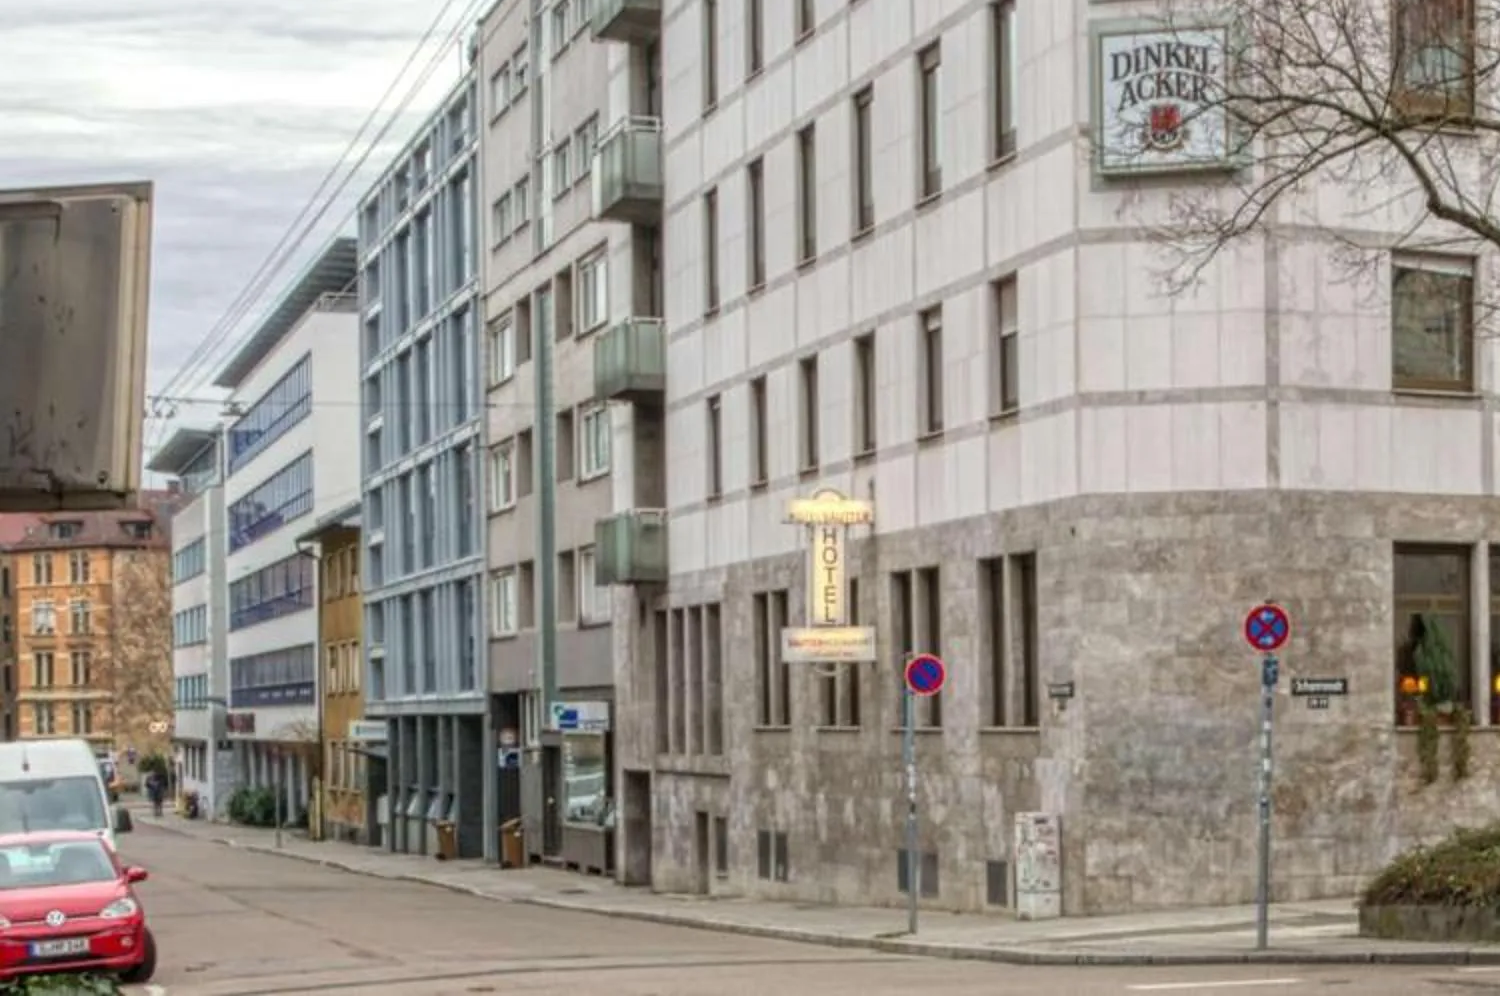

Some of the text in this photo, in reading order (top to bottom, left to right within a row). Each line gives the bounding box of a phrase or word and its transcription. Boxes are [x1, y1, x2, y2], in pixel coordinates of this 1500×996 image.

[1110, 42, 1217, 82] DINKEL
[1118, 71, 1213, 112] ACKER
[822, 527, 838, 623] HOTEL
